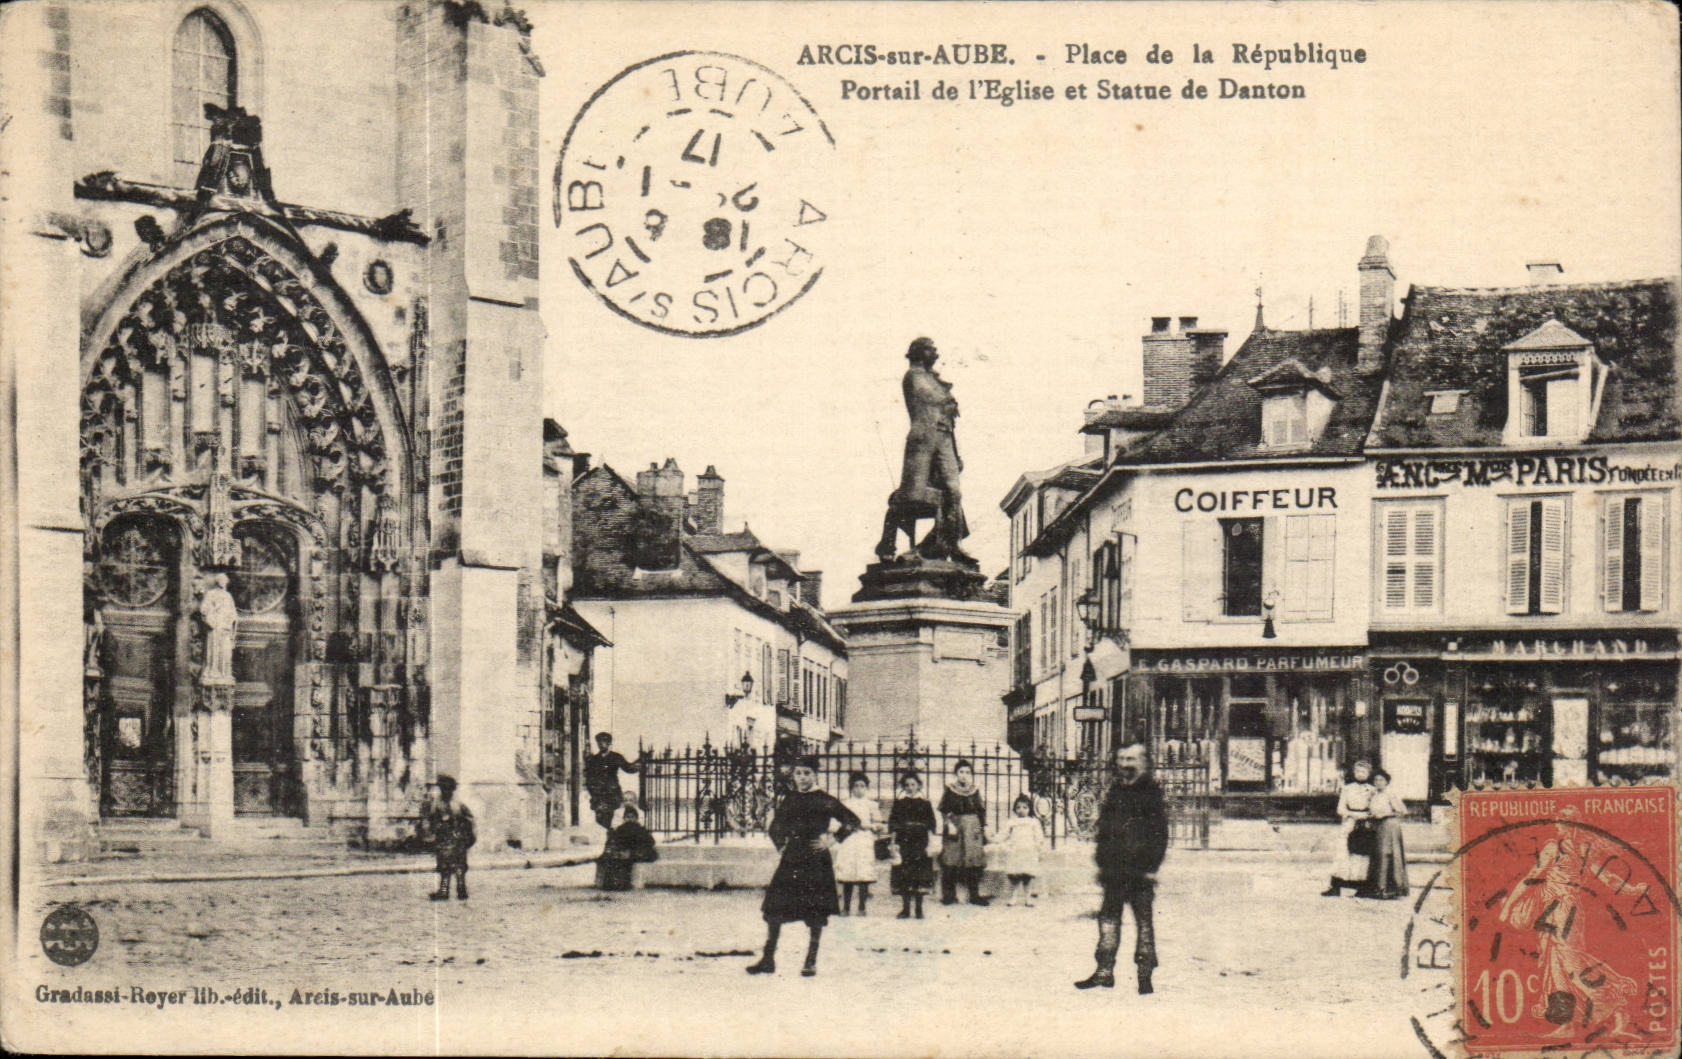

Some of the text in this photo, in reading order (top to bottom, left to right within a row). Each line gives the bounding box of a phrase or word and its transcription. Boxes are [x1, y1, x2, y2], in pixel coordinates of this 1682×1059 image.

[1516, 457, 1607, 486] PARIS
[1175, 486, 1338, 513] COIFFEUR
[1492, 638, 1649, 655] MARCHAND
[1158, 656, 1249, 672] GASPARD
[1256, 655, 1365, 671] PARFUMEUR
[1584, 797, 1665, 816] FRANÇAISE
[1649, 946, 1668, 1033] POSTES
